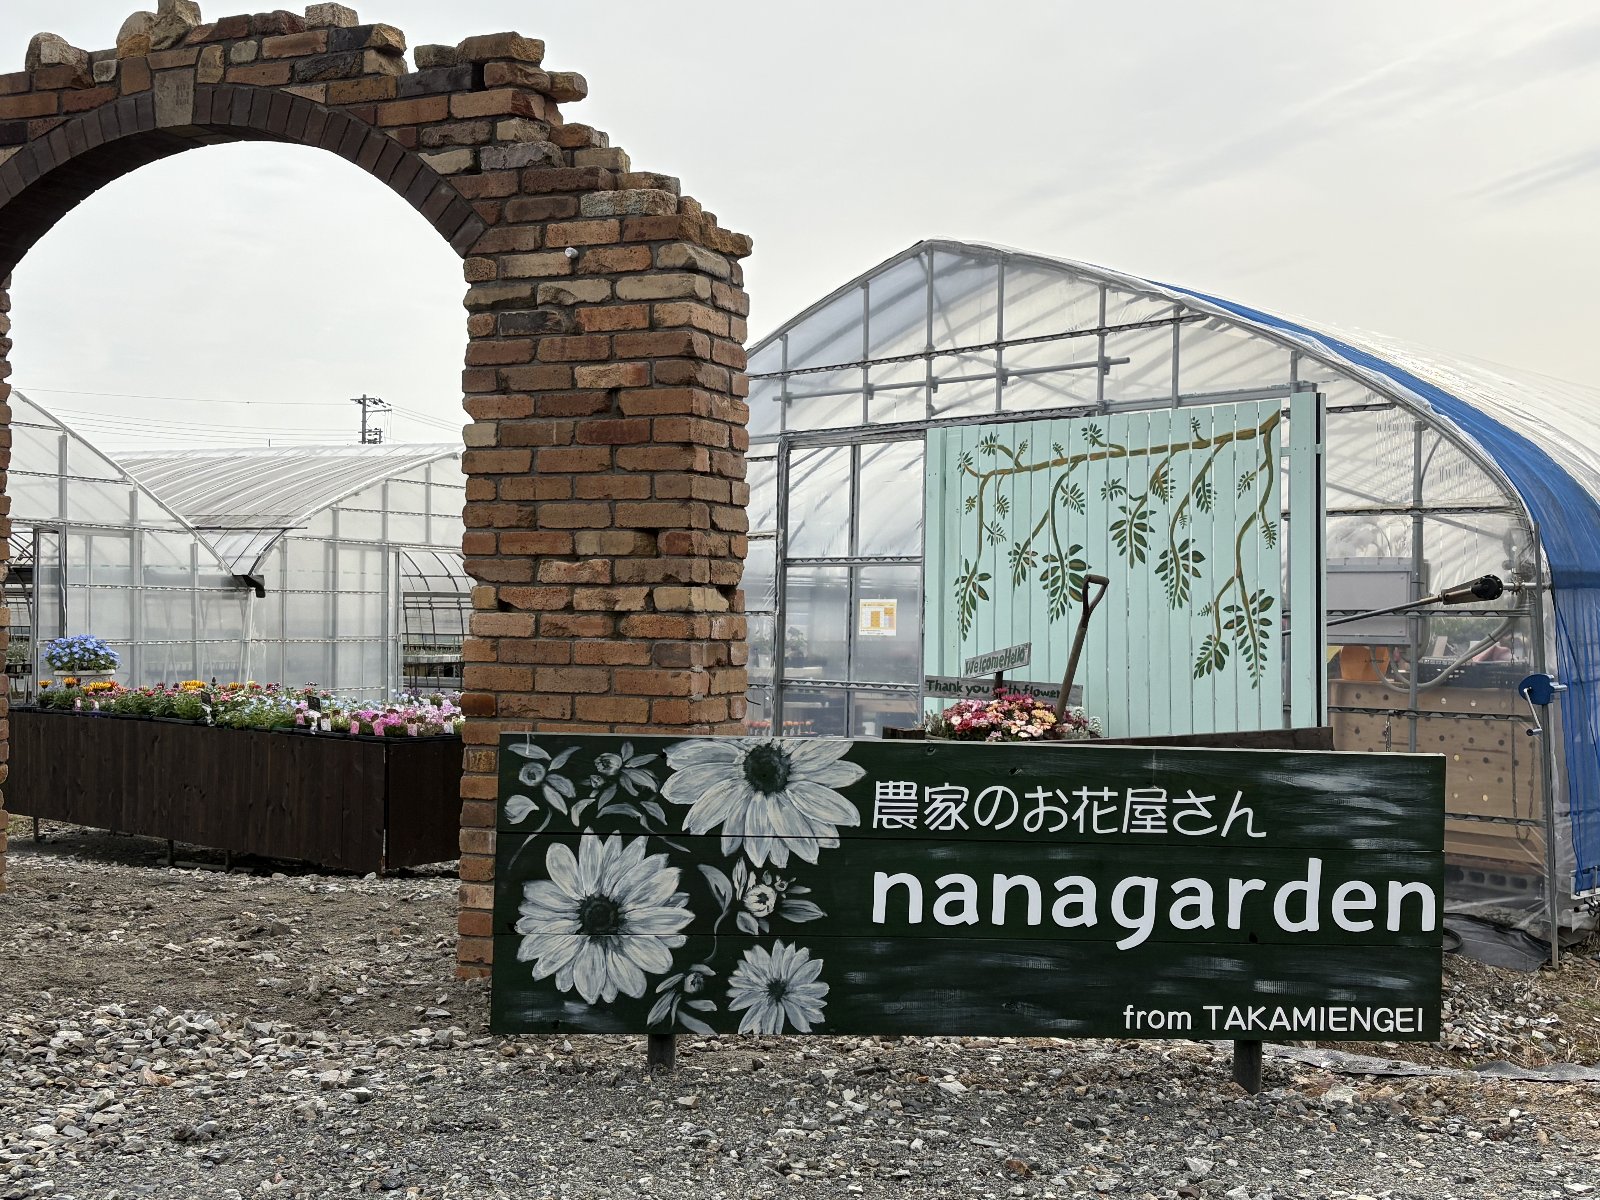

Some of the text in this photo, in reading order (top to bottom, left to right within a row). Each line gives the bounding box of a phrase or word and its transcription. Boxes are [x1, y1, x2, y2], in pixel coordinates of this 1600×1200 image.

[926, 679, 962, 693] Thank
[965, 684, 990, 697] you
[872, 780, 1267, 838] 農家のお花屋さん
[872, 857, 1436, 951] nanagarden
[1122, 1004, 1423, 1033] from TAKAMIENGEI
